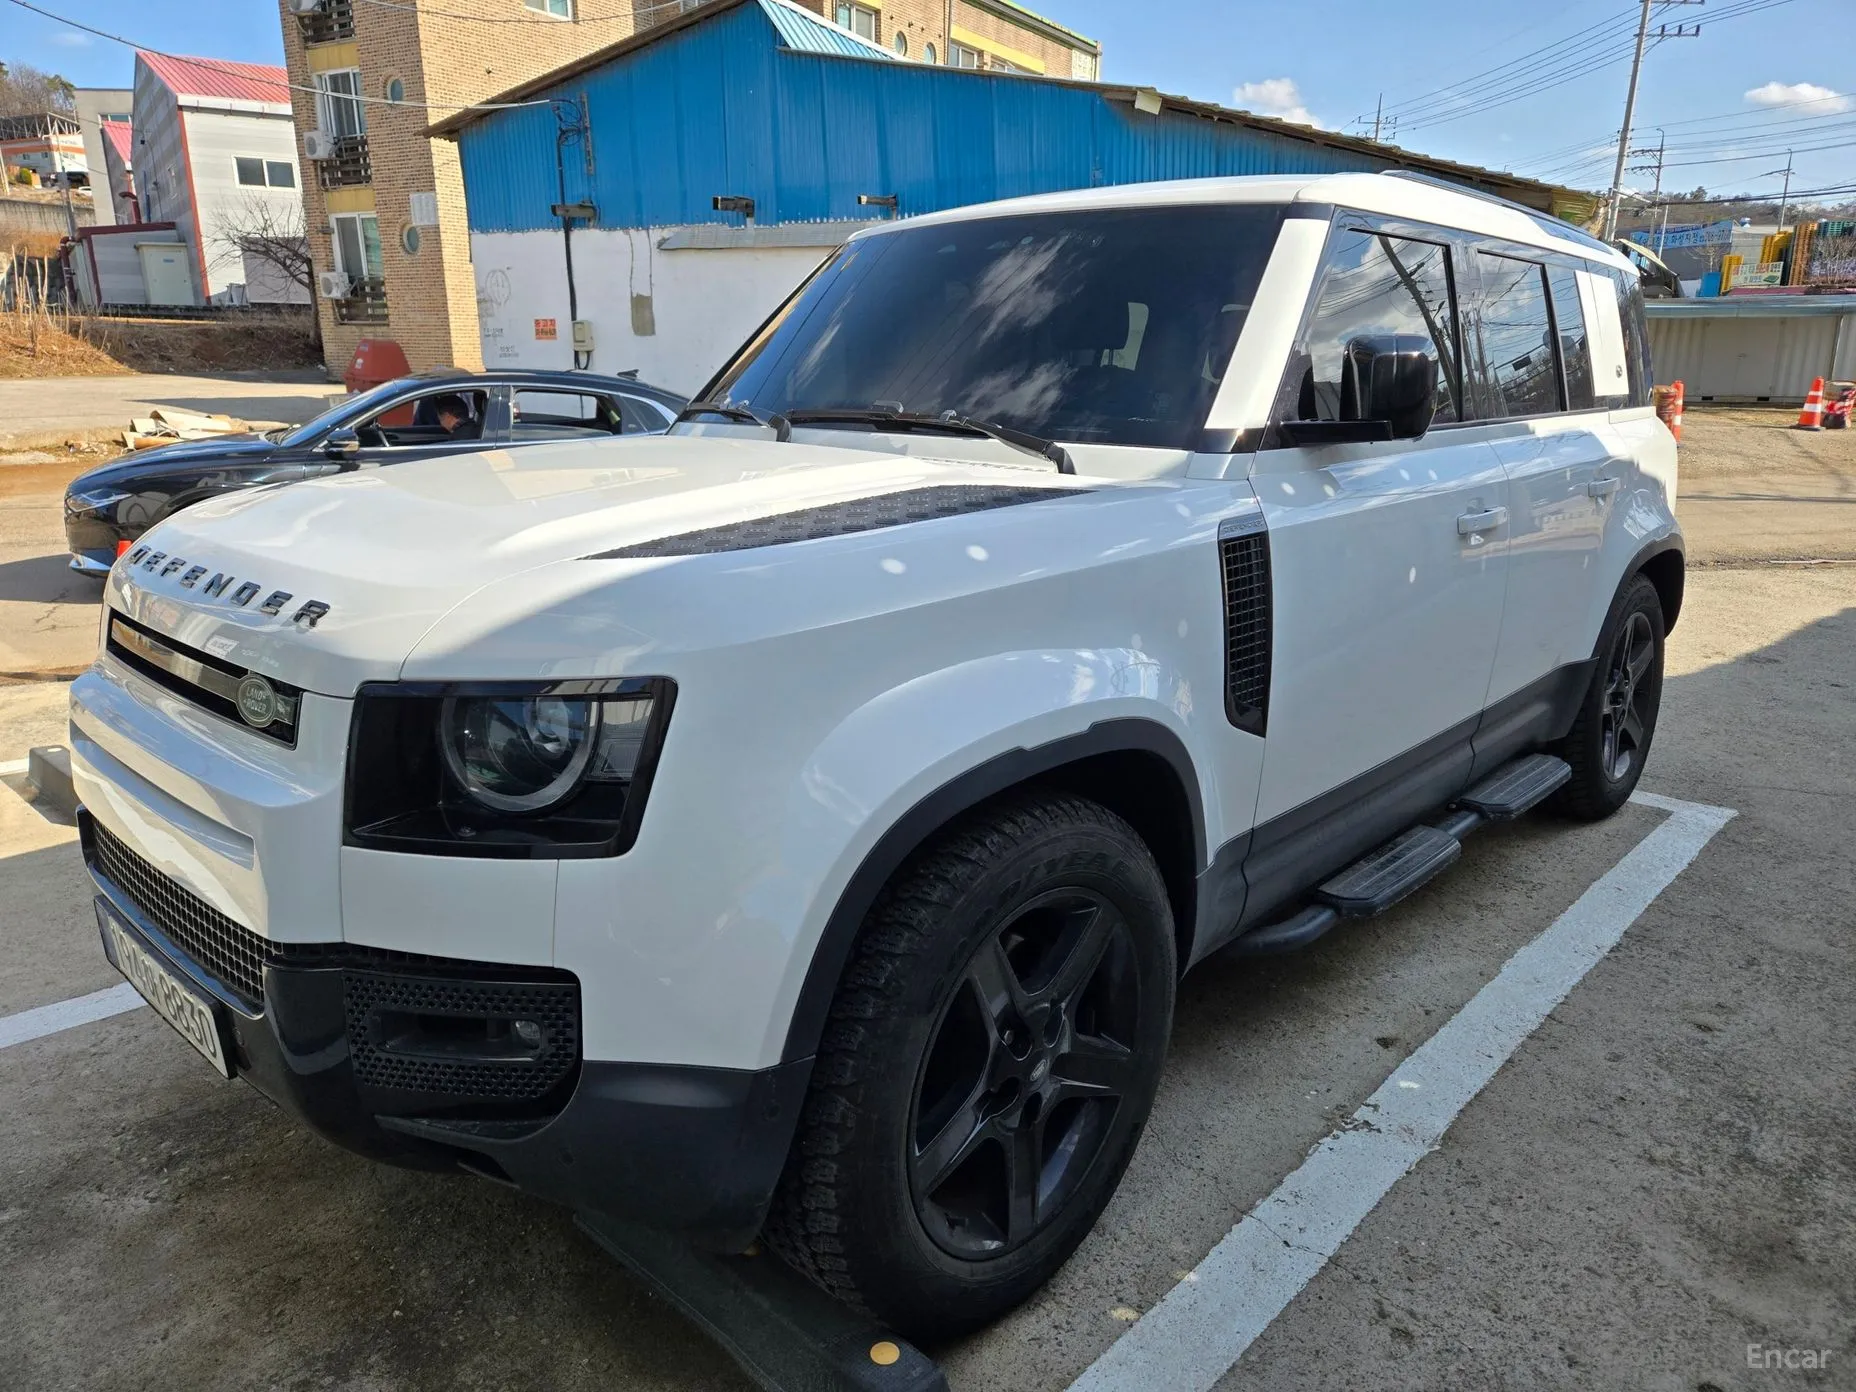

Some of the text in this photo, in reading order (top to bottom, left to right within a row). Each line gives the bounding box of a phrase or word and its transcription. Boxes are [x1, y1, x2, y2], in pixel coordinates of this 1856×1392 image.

[130, 545, 331, 628] DEFENDER
[245, 698, 267, 714] ROVER
[246, 686, 263, 701] LAND
[158, 970, 217, 1059] 8830
